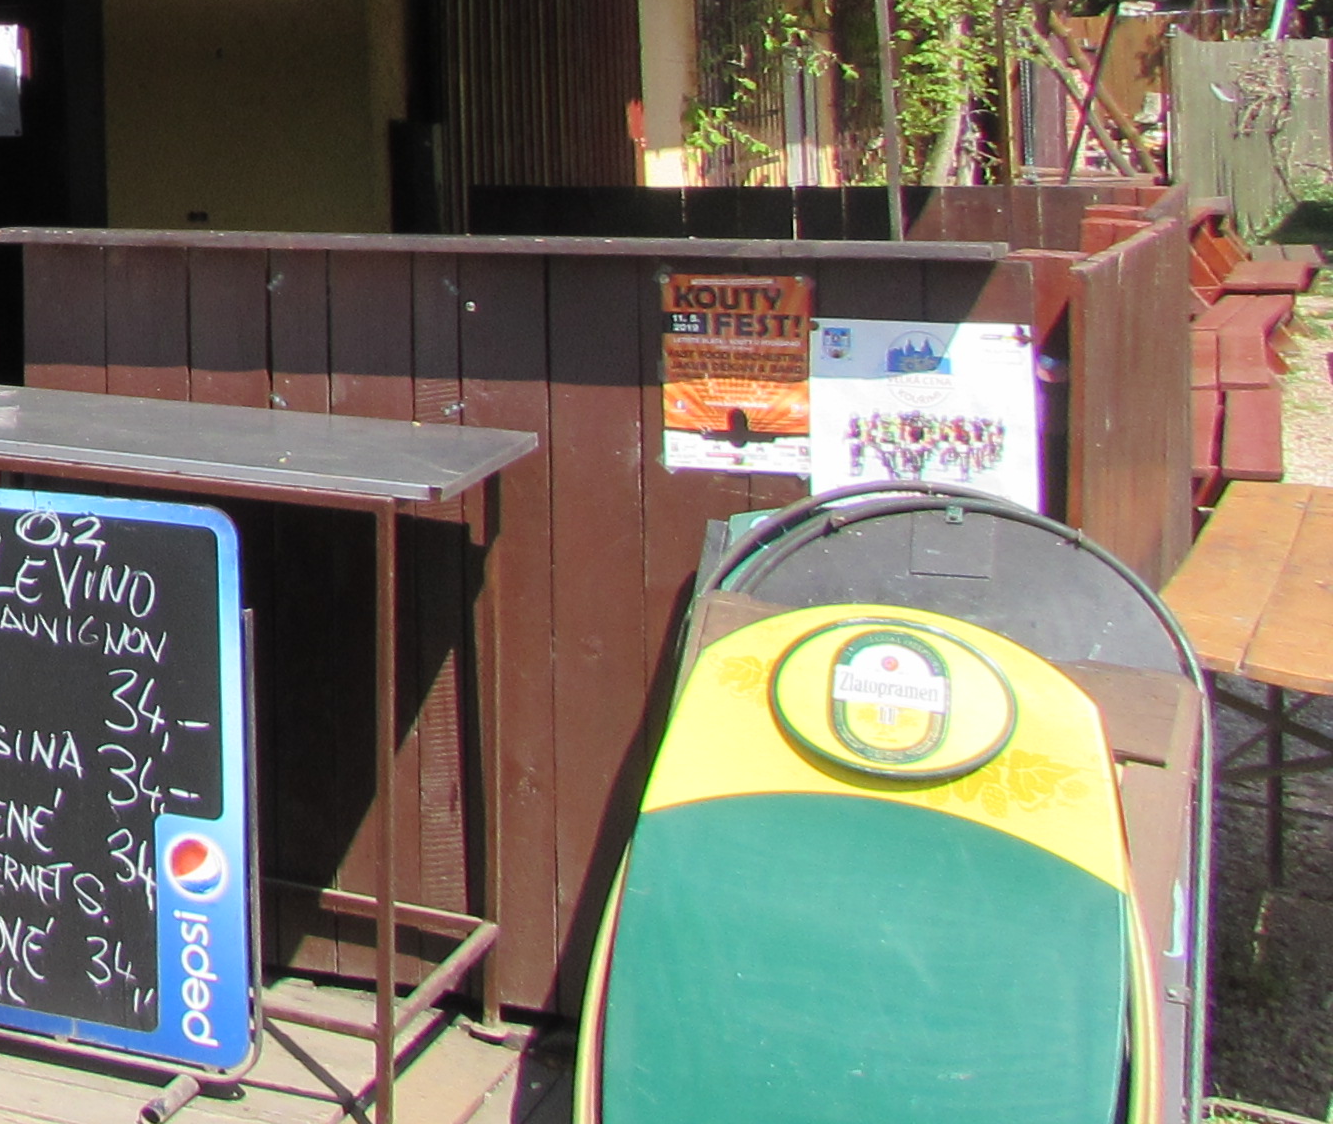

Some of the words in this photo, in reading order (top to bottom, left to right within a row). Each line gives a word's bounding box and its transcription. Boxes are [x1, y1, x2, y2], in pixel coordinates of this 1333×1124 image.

[672, 285, 782, 311] KOUTY
[672, 323, 700, 334] 2019
[714, 313, 805, 338] FEST!
[838, 671, 940, 704] Zlatopramen
[172, 908, 220, 1048] pepsi
